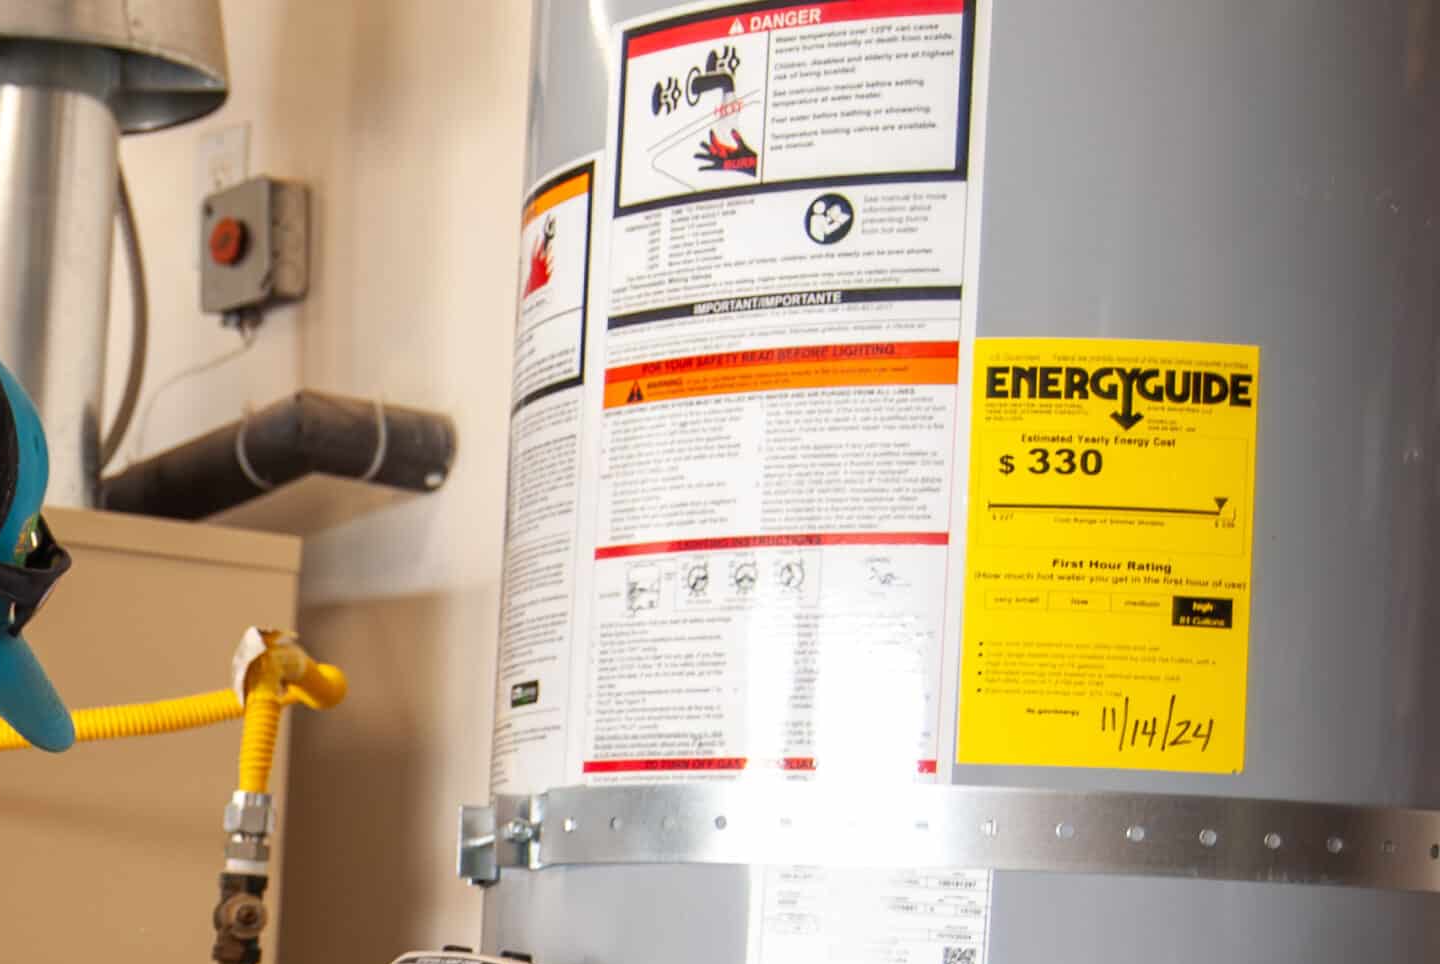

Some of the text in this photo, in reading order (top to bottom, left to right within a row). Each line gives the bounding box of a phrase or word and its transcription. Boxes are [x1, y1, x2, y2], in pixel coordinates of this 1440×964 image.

[749, 8, 822, 32] DANGER
[693, 292, 842, 315] IMPORTANT/IMPORTANTE
[641, 344, 895, 374] FOR YOUR SAFETY READ BEFORE LIGHTING
[985, 366, 1252, 408] ENERGYGUIDE
[1021, 434, 1176, 448] Estimated Yearly Energy Cost
[999, 448, 1103, 476] $ 330
[1052, 559, 1172, 574] First Hour Rating
[1004, 572, 1034, 581] much
[1037, 573, 1054, 581] hot
[1058, 574, 1086, 582] water
[1090, 575, 1109, 584] you
[1112, 575, 1128, 585] get
[1131, 576, 1141, 584] in
[1143, 576, 1160, 585] the
[1162, 577, 1183, 586] first
[1186, 578, 1209, 587] hour
[1212, 580, 1222, 588] of
[1101, 693, 1215, 752] 11/14/24
